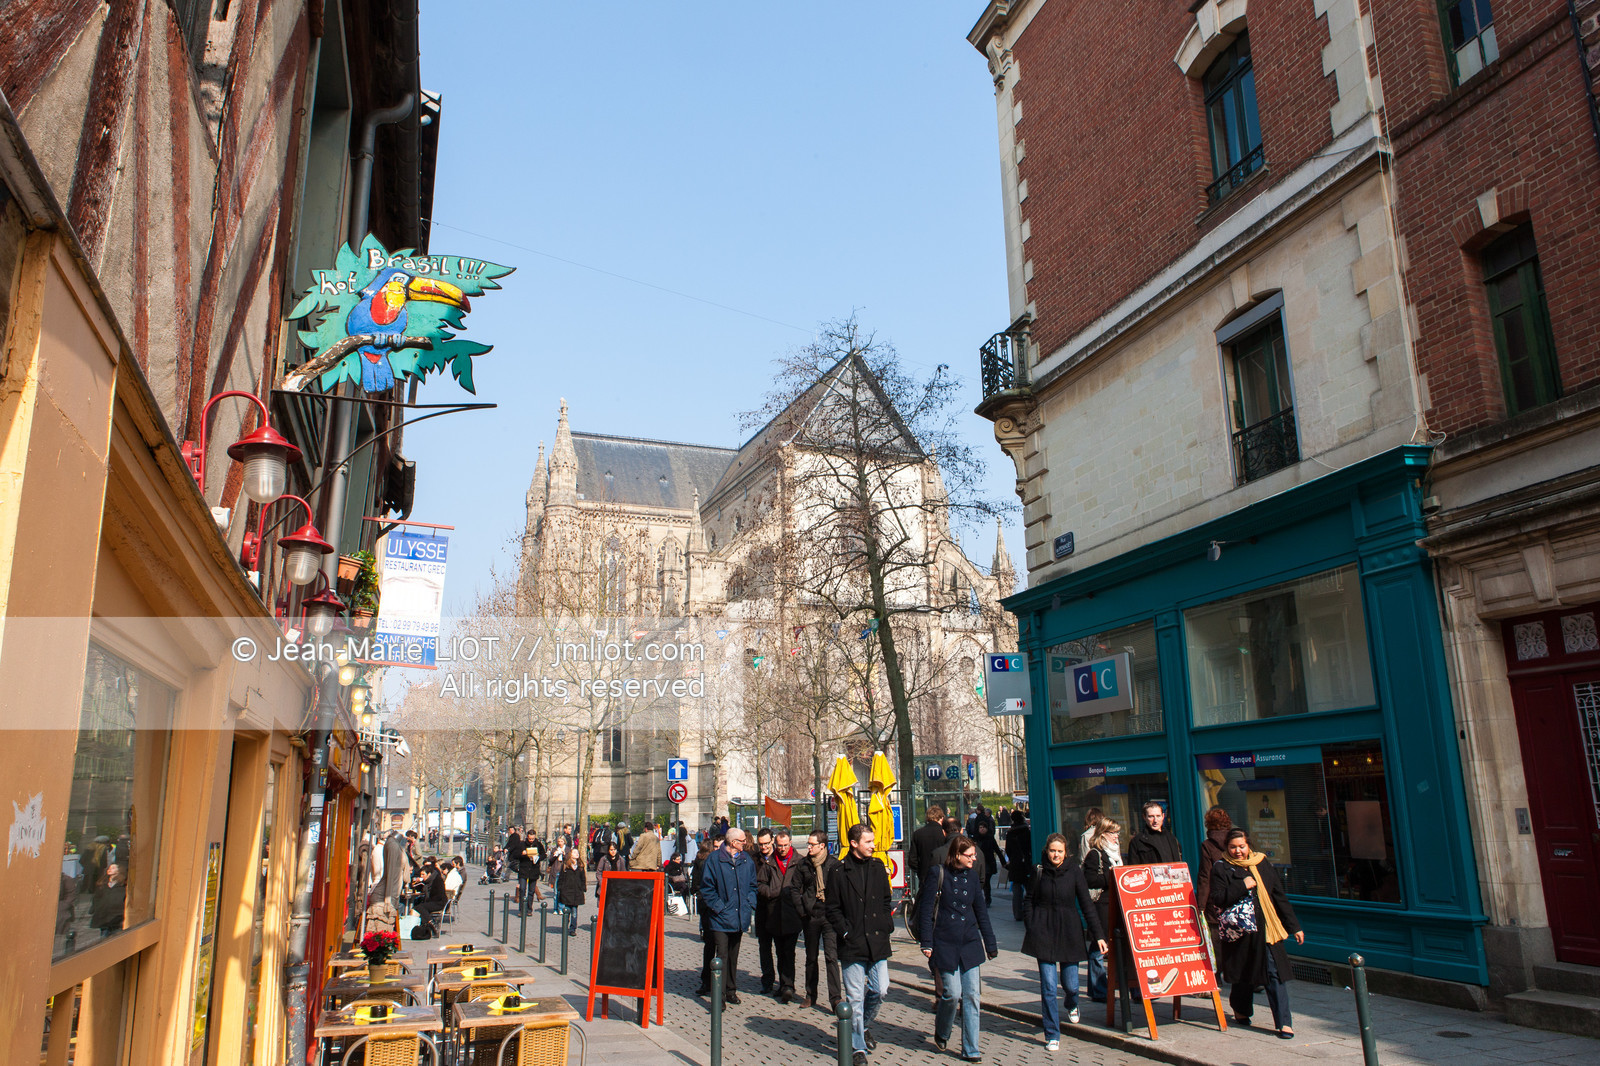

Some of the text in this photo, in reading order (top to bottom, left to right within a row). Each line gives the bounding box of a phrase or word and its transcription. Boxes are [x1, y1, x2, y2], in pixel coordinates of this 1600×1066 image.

[367, 248, 451, 276] Brasil
[387, 538, 447, 561] ULYSSE
[385, 560, 446, 575] RESTAURANT GREC
[994, 658, 1020, 670] CIC
[1078, 668, 1113, 695] CIC
[1230, 753, 1286, 765] Banque Assurance
[1088, 765, 1127, 775] Banque Assurance
[1134, 892, 1185, 908] Menu complet
[1133, 913, 1157, 923] 5,10€
[1172, 910, 1185, 919] 6€
[1137, 956, 1156, 968] Panini
[1155, 954, 1175, 966] Nutella
[1184, 969, 1208, 988] 1,80€
